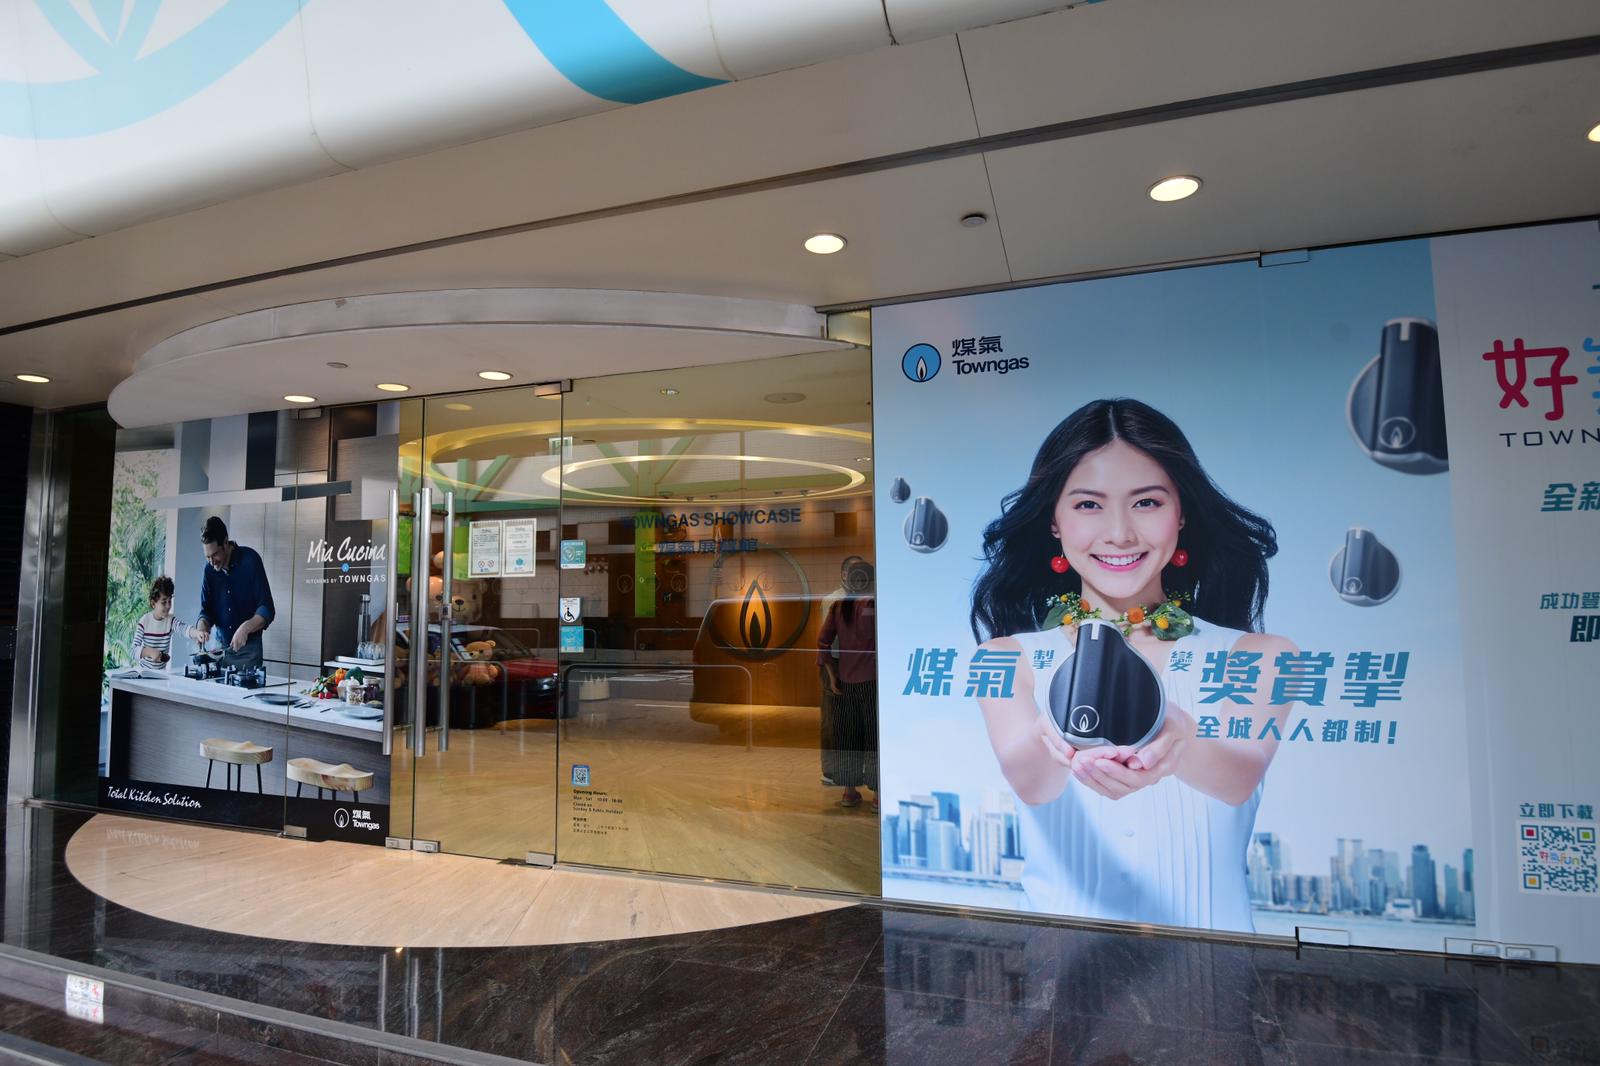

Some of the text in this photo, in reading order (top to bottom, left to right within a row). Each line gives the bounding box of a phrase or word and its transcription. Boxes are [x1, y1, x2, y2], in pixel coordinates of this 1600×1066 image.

[951, 335, 1004, 357] 煤氣
[951, 356, 1030, 375] Towngas
[1482, 337, 1600, 421] 好
[703, 507, 802, 526] SHOWCASE
[307, 536, 386, 563] Mia Cucina
[339, 574, 386, 584] TOWNGAS
[108, 786, 202, 808] Total Kitchen Solution
[1519, 802, 1593, 820] 立即下載
[352, 819, 380, 831] Towngas
